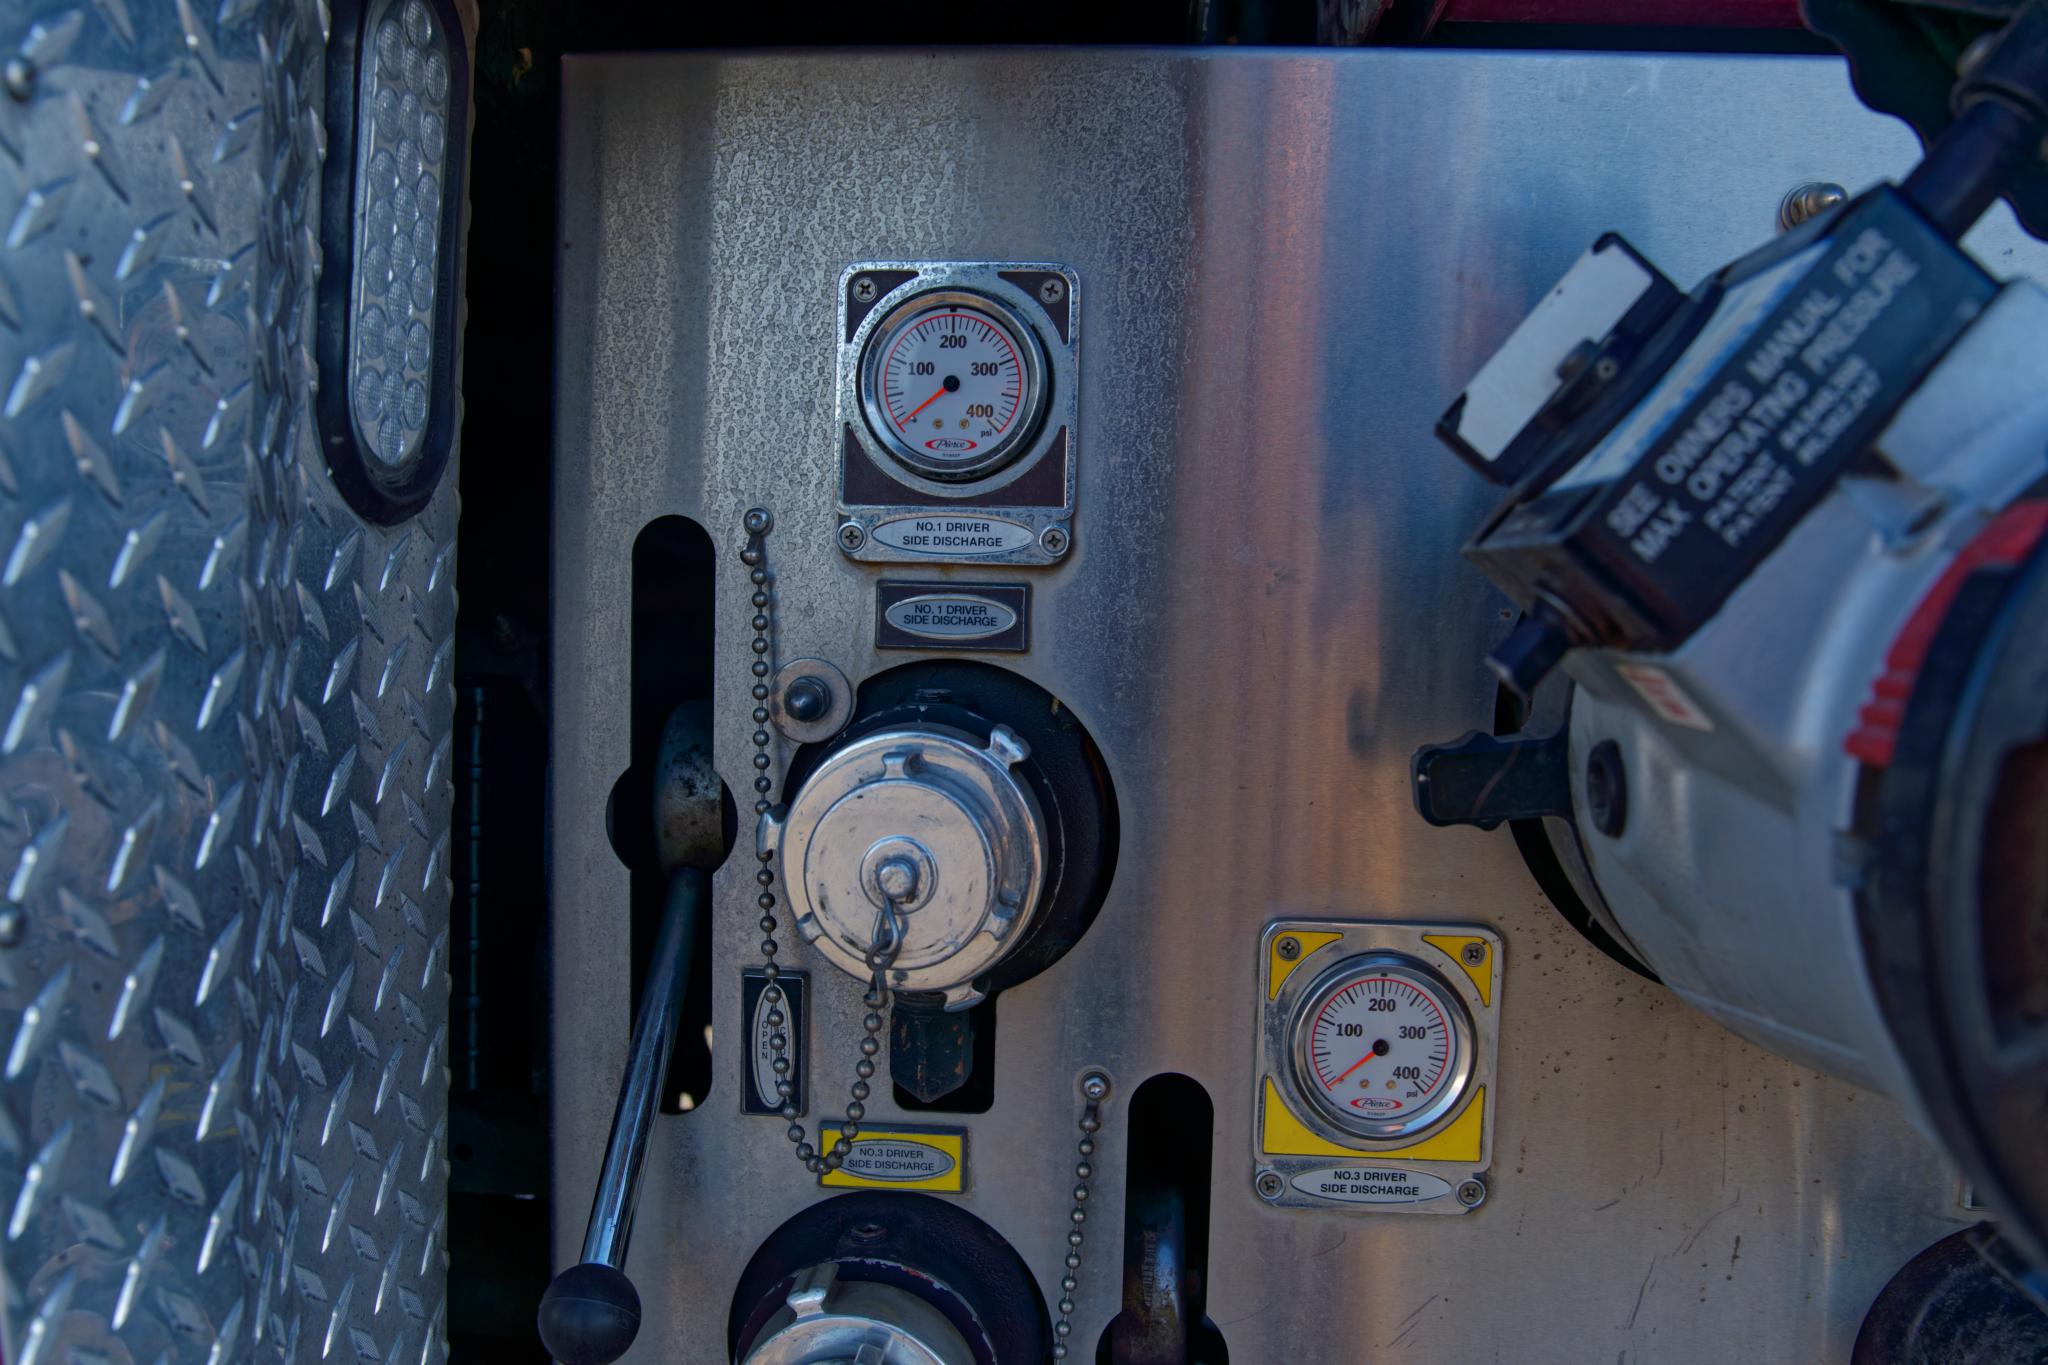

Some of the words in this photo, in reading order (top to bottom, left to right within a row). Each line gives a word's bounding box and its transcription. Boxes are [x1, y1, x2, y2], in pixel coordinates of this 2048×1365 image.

[939, 334, 967, 349] 200
[908, 362, 935, 376] 100
[970, 362, 999, 376] 300
[1607, 481, 1661, 538] SEE
[1655, 380, 1752, 484] OWNERS
[1746, 289, 1841, 384] MANUAL
[1833, 228, 1892, 287] FOR
[966, 404, 994, 418] 400
[1630, 498, 1692, 564] MAX
[1801, 249, 1920, 375] PRESSURE
[980, 428, 993, 438] psi
[1704, 450, 1776, 530] PATENT
[1721, 464, 1795, 547] PATENT
[916, 521, 942, 532] NO.1
[946, 522, 990, 533] DRIVER
[902, 535, 931, 546] SIDE
[933, 535, 1003, 547] DISCHARGE
[946, 605, 987, 615] DRIVER
[903, 615, 929, 625] SIDE
[932, 615, 998, 626] DISCHARGE
[1368, 998, 1396, 1013] 200
[1335, 1023, 1363, 1037] 100
[1398, 1026, 1427, 1040] 300
[761, 1020, 769, 1060] OPEN
[1392, 1066, 1420, 1080] 400
[1406, 1089, 1418, 1099] psi
[859, 1147, 884, 1157] NO.3
[886, 1149, 924, 1159] DRIVER
[848, 1159, 872, 1169] SIDE
[874, 1160, 935, 1171] DISCHARGE
[1333, 1170, 1361, 1181] NO.3
[1364, 1171, 1408, 1182] DRIVER
[1320, 1183, 1348, 1194] SIDE
[1350, 1184, 1420, 1196] DISCHARGE
